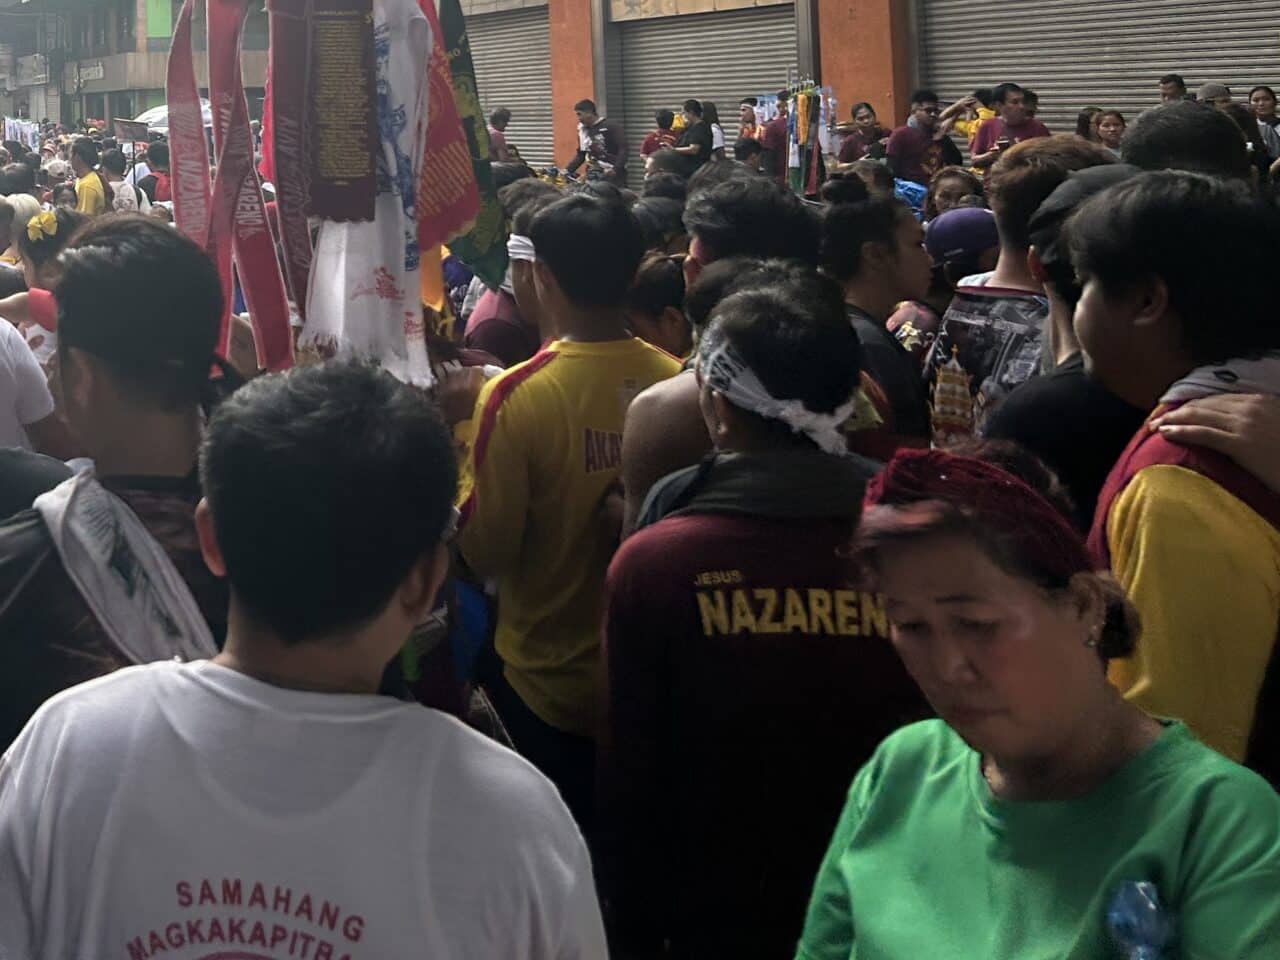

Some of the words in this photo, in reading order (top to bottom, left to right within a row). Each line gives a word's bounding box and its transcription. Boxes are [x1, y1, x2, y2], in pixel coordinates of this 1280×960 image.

[694, 570, 742, 586] JESUS
[696, 587, 890, 638] NAZAREN
[176, 878, 365, 942] SAMAHANG
